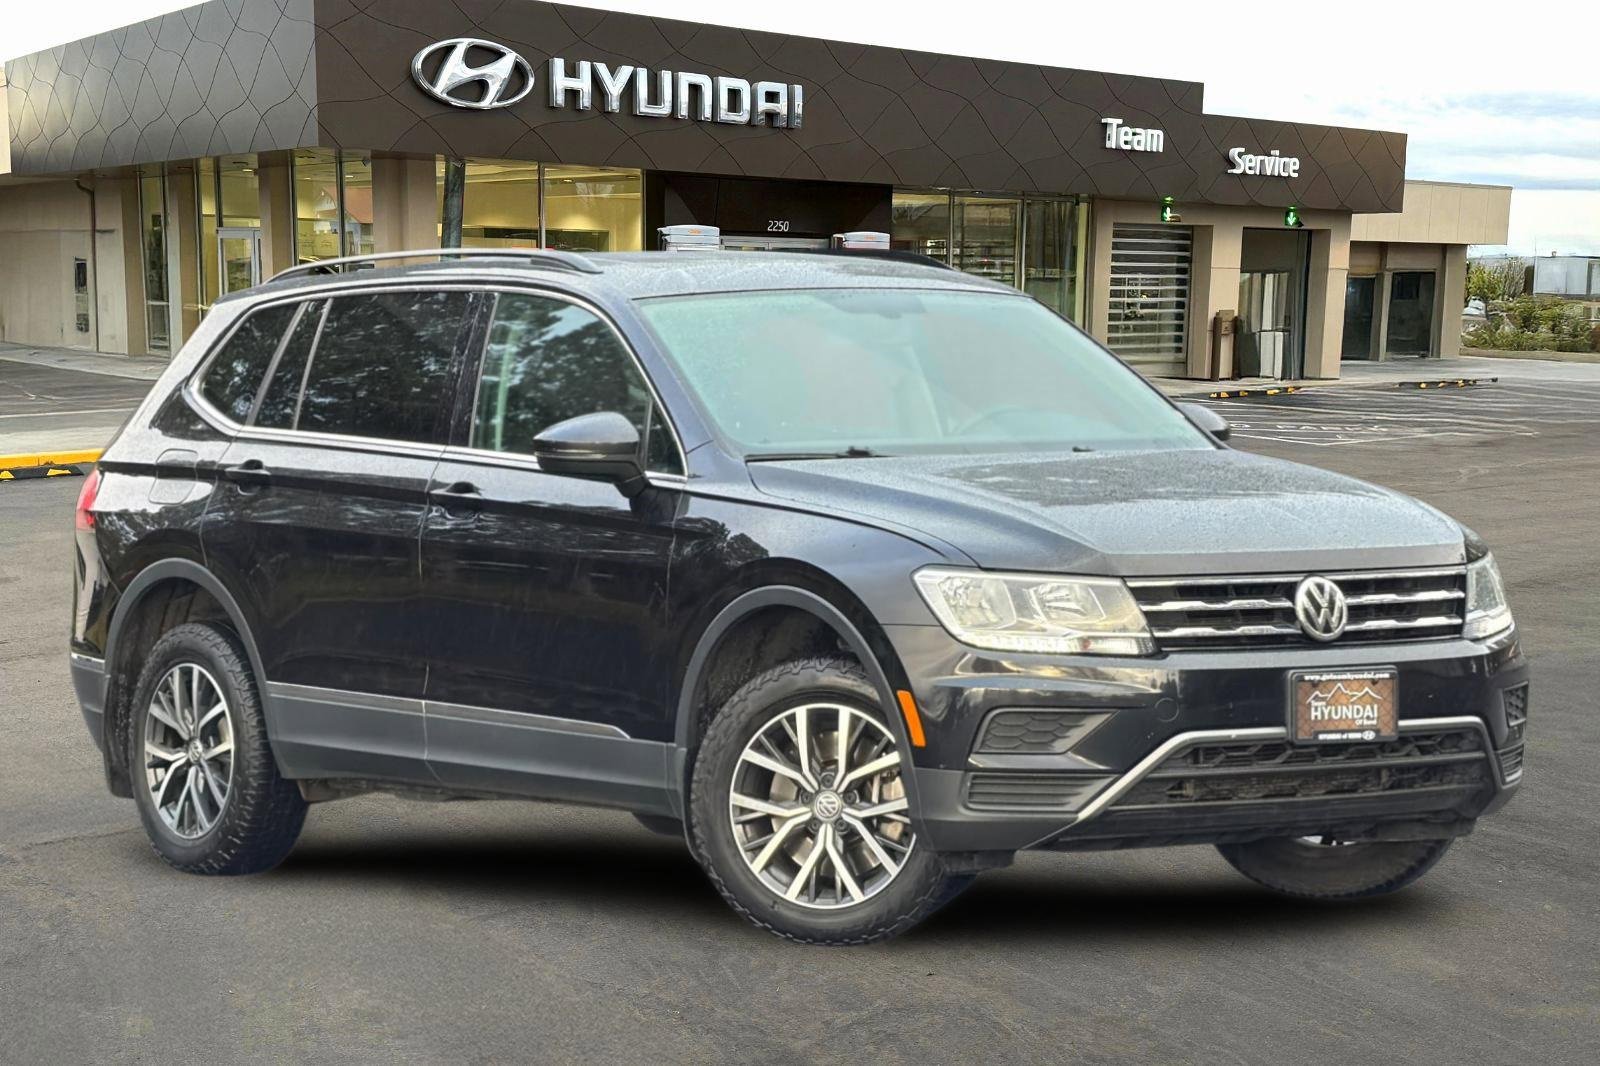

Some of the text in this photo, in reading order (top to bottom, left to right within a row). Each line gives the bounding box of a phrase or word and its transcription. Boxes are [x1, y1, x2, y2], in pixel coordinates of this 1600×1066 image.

[549, 57, 802, 129] HYUNDAI
[1102, 117, 1164, 152] Team
[1227, 147, 1300, 178] Service
[767, 220, 790, 232] 2250
[1310, 704, 1378, 720] HYUNDAI
